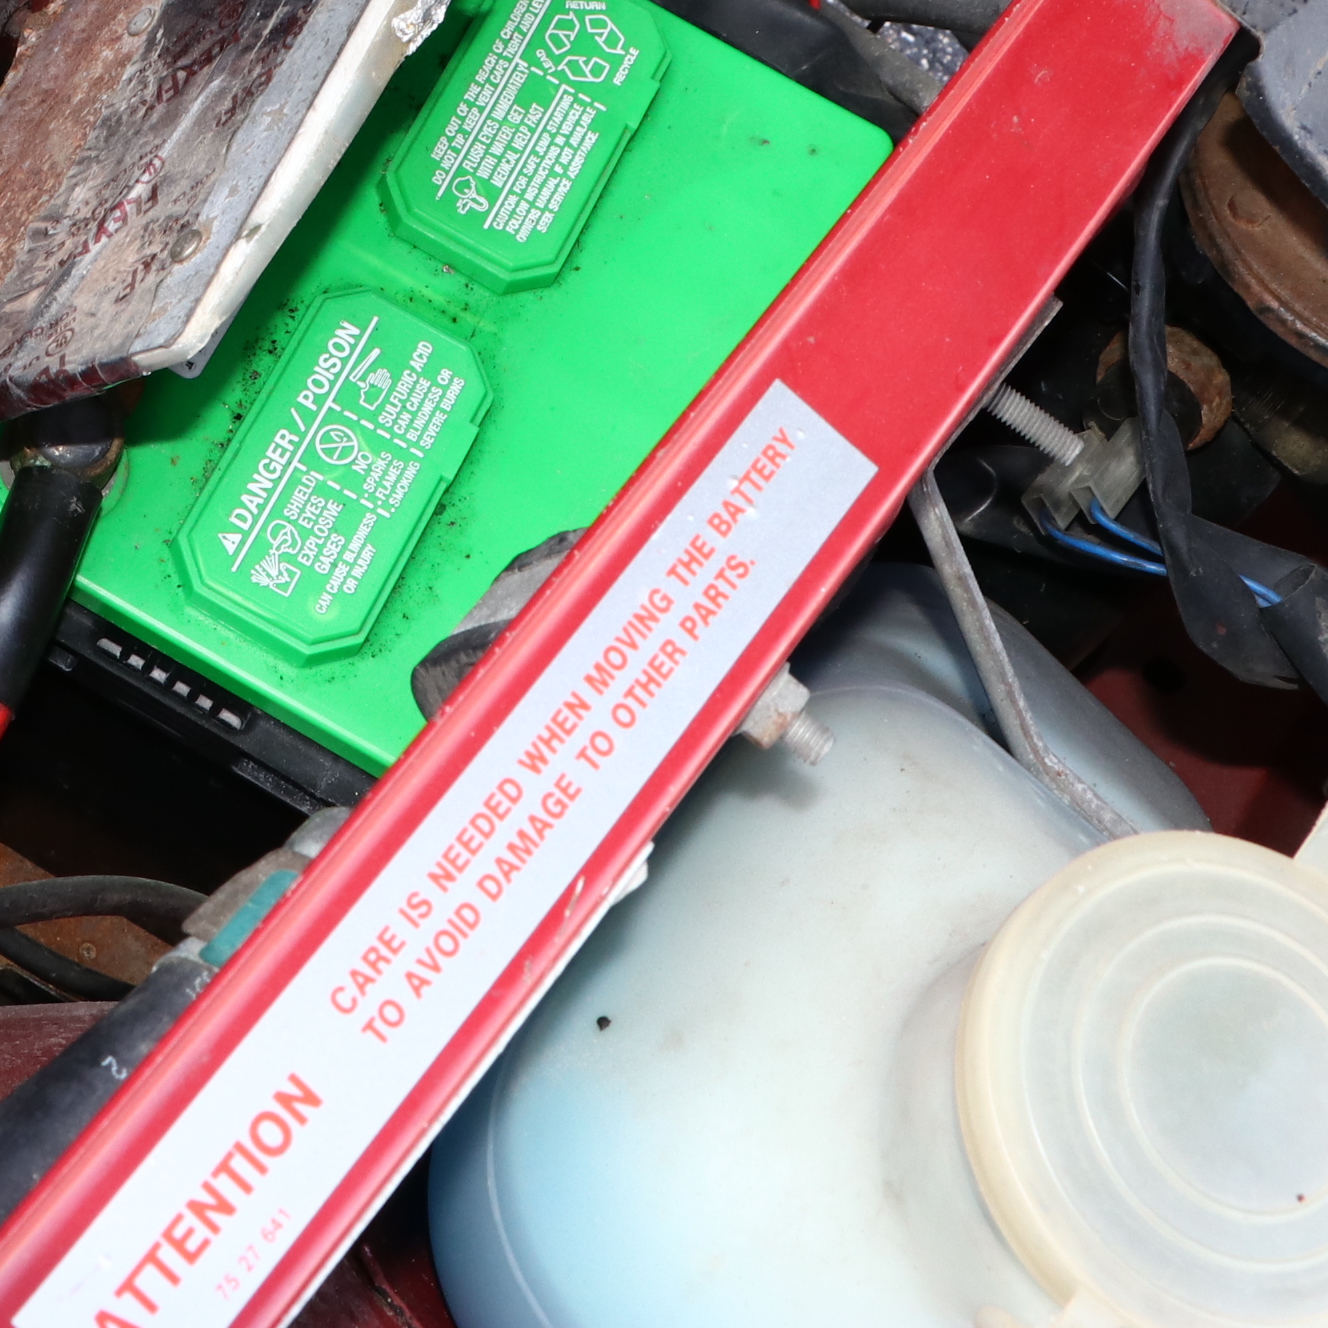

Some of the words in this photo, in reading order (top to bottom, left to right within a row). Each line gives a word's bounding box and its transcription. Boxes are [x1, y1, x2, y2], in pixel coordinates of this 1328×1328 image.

[564, 0, 607, 12] RETURN
[613, 47, 639, 85] RECYCLE
[431, 137, 449, 160] KEEP
[446, 116, 461, 136] OUT
[457, 102, 469, 116] OF
[464, 83, 481, 101] THE
[476, 53, 498, 83] REACH
[493, 39, 504, 53] OF
[432, 170, 446, 184] DO
[441, 150, 458, 169] NOT
[452, 134, 467, 149] TIP.
[463, 108, 480, 131] KEEP
[476, 83, 494, 106] VENT
[490, 60, 509, 83] CAPS
[503, 32, 523, 58] TIGHT
[520, 13, 535, 33] AND
[463, 142, 486, 172] FLUSH
[478, 120, 499, 143] EYES
[491, 63, 529, 120] IMMEDIATELY
[560, 103, 583, 134] VEHICLE
[476, 155, 497, 178] WITH
[508, 105, 525, 123] GET
[491, 151, 520, 187] MEDICAL
[512, 126, 531, 150] HELP
[524, 103, 544, 127] FAST
[513, 176, 528, 193] FOR
[523, 155, 540, 175] SAFE
[535, 133, 551, 155] JUMP
[547, 95, 573, 133] STARTING
[555, 135, 566, 145] IN
[516, 209, 541, 242] OWNERS
[554, 164, 563, 173] IF
[559, 147, 574, 164] NOT
[570, 107, 596, 147] AVAILABLE
[524, 146, 560, 201] INSTRUCTIONS
[506, 200, 529, 234] FOLLOW
[537, 211, 554, 232] SEEK
[549, 178, 572, 211] SERVICE
[379, 370, 417, 426] SULFURIC
[410, 341, 432, 372] ACID
[394, 412, 412, 434] CAN
[406, 377, 431, 411] CAUSE
[406, 387, 442, 441] BLINDNESS
[438, 369, 452, 384] OR
[420, 411, 447, 449] SEVERE
[440, 377, 464, 411] BURNS
[229, 429, 299, 530] DANGER
[297, 321, 360, 411] POISON
[352, 451, 374, 474] NO
[363, 452, 391, 492] SPARKS
[376, 460, 404, 500] FLAMES
[389, 461, 419, 507] SMOKING
[284, 475, 316, 519] SHIELD
[298, 496, 325, 528] EYES
[298, 500, 342, 566] EXPLOSIVE
[315, 534, 345, 573] GASES
[316, 593, 332, 613] CAN
[326, 562, 350, 593] CAUSE
[343, 513, 376, 563] BLINDNESS
[343, 578, 358, 593] OR
[351, 544, 375, 578] INJURY
[331, 926, 405, 1014] CARE
[399, 892, 432, 928] IS
[428, 778, 522, 892] NEEDED
[518, 692, 591, 774] WHEN
[584, 589, 674, 695] MOVING
[667, 535, 715, 585] THE
[707, 428, 794, 537] BATTERY
[362, 1000, 404, 1042] TO
[405, 903, 480, 998] AVOID
[477, 774, 581, 901] DAMAGE
[576, 731, 614, 769] TO
[612, 639, 686, 728] OTHER
[679, 555, 754, 640] PARTS.
[216, 1274, 239, 1298] 75
[238, 1244, 259, 1272] 27
[261, 1208, 289, 1242] 641
